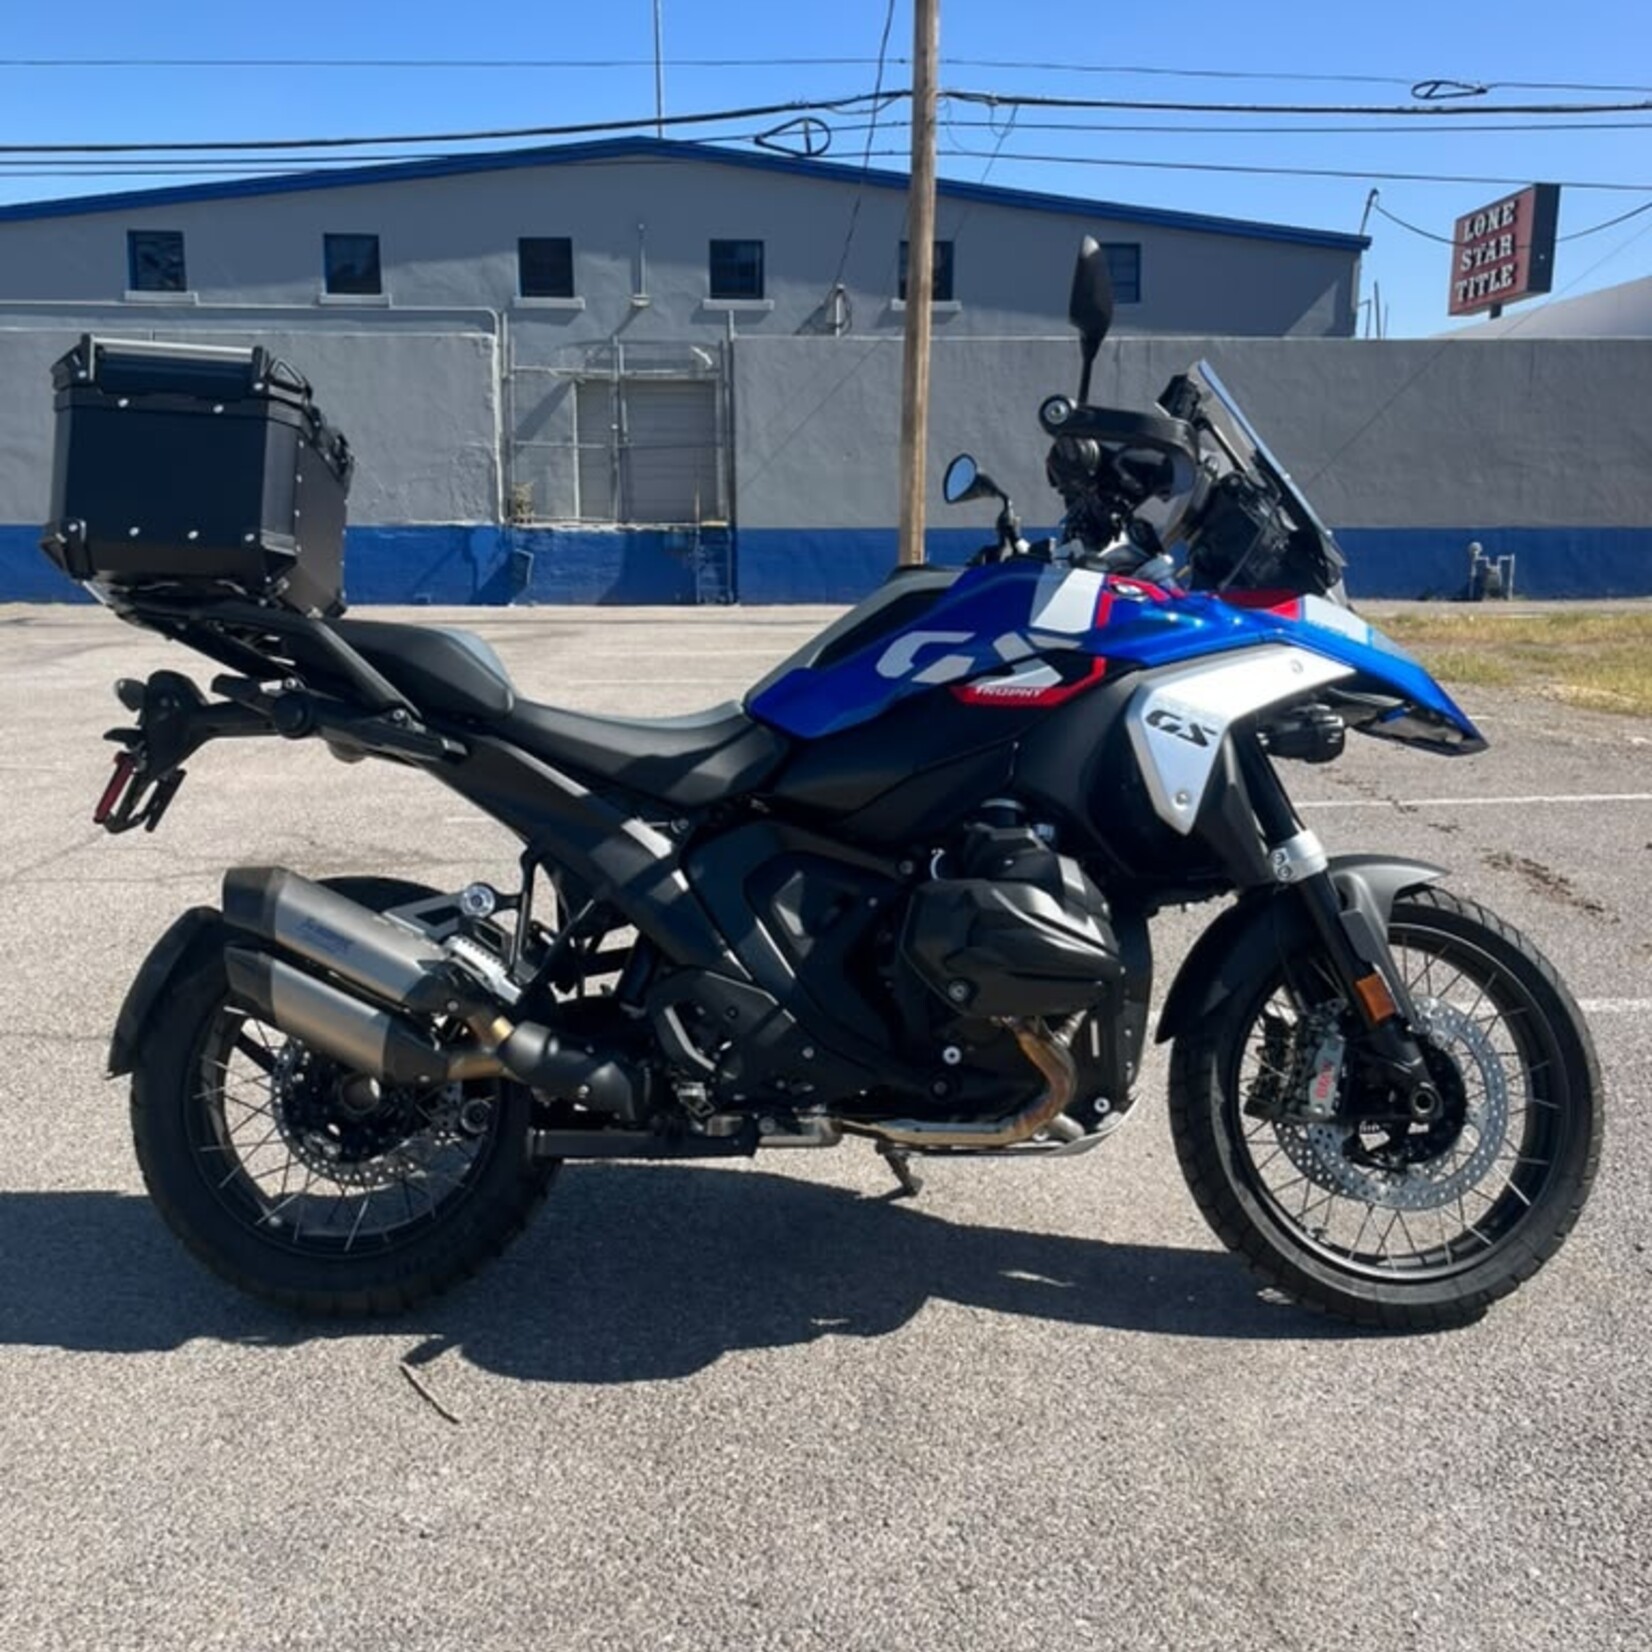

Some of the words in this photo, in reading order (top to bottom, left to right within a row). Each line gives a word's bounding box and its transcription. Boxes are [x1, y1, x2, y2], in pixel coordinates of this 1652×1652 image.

[1463, 200, 1517, 243] LONE
[1460, 232, 1513, 273] STAR
[1455, 263, 1515, 303] TITLE
[875, 631, 1083, 684] GS
[1145, 709, 1218, 748] GS
